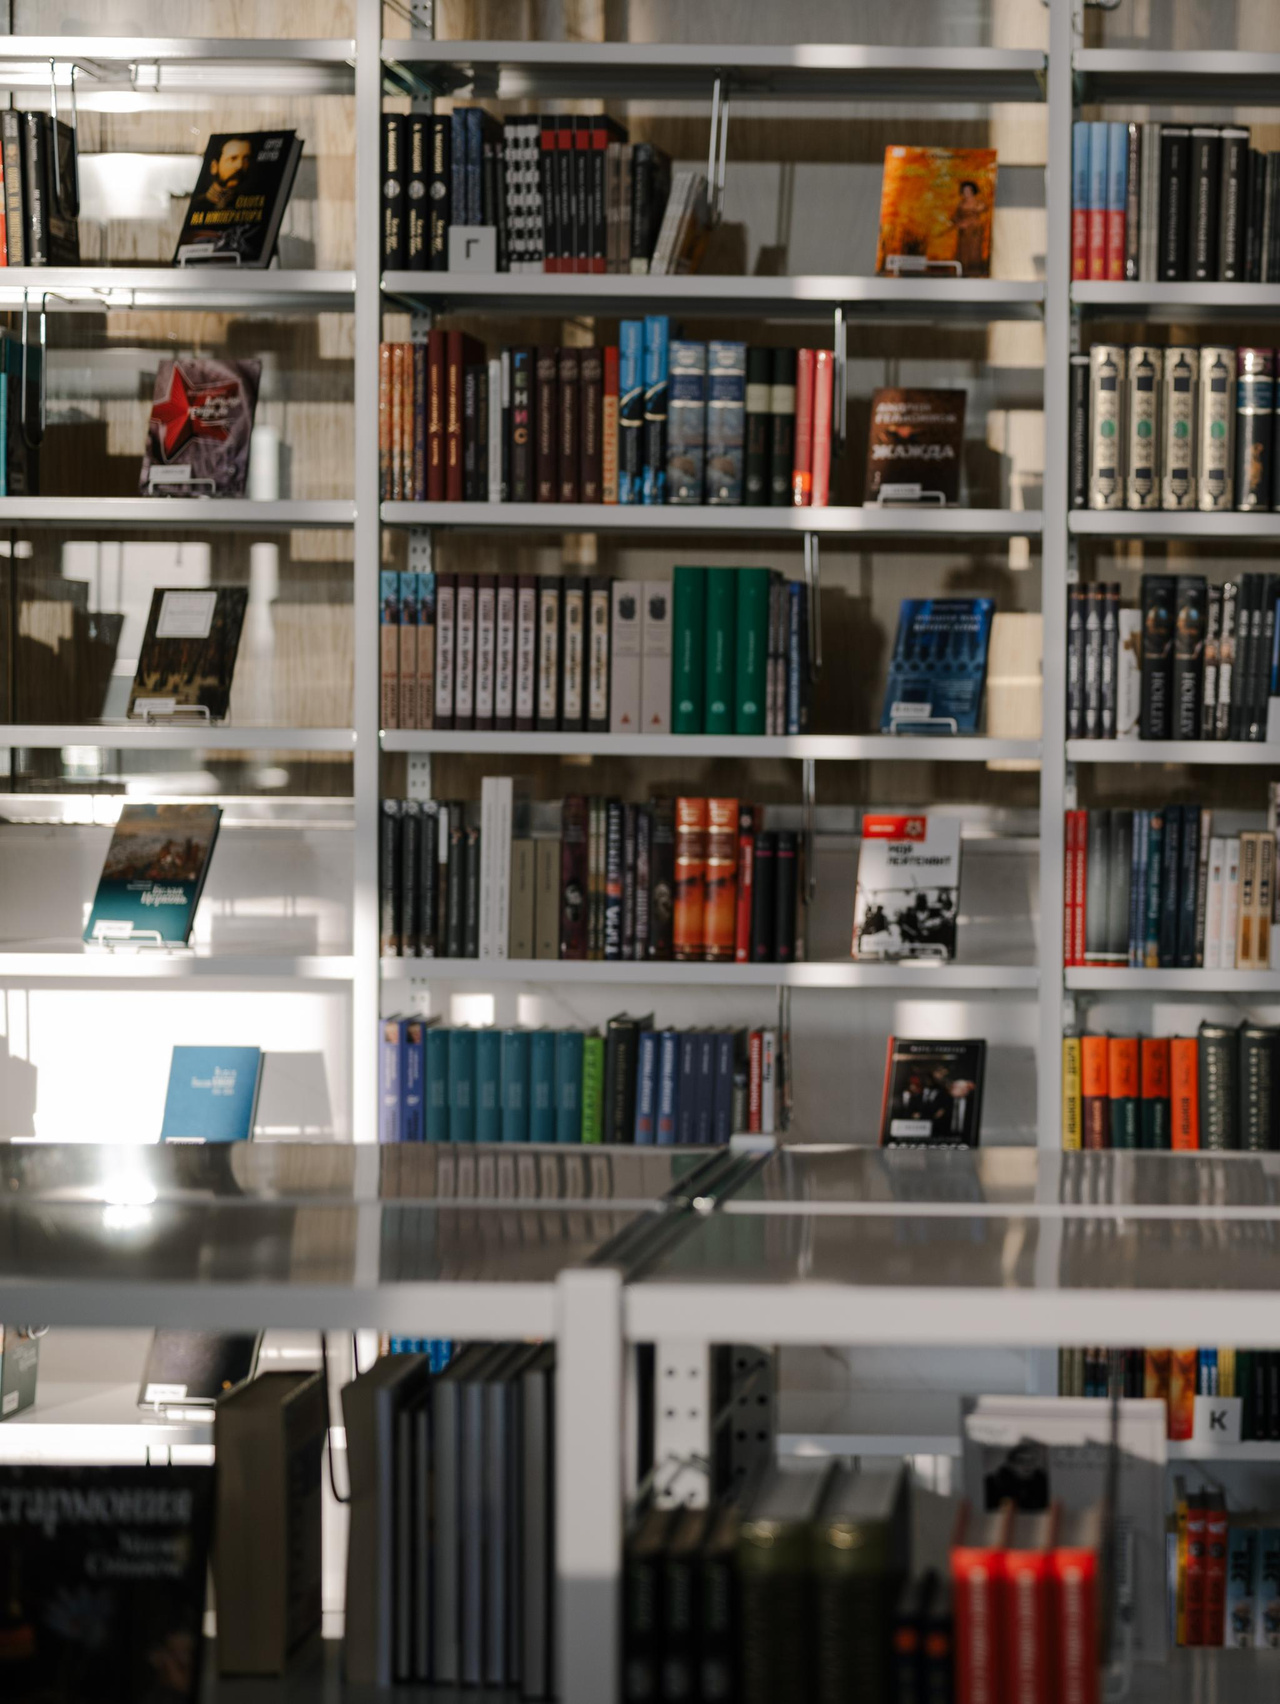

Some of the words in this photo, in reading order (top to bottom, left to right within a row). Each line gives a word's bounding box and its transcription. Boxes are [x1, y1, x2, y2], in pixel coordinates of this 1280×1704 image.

[465, 238, 480, 259] Г
[514, 352, 529, 445] ГЕНИС
[871, 442, 955, 461] ЖАЖДА
